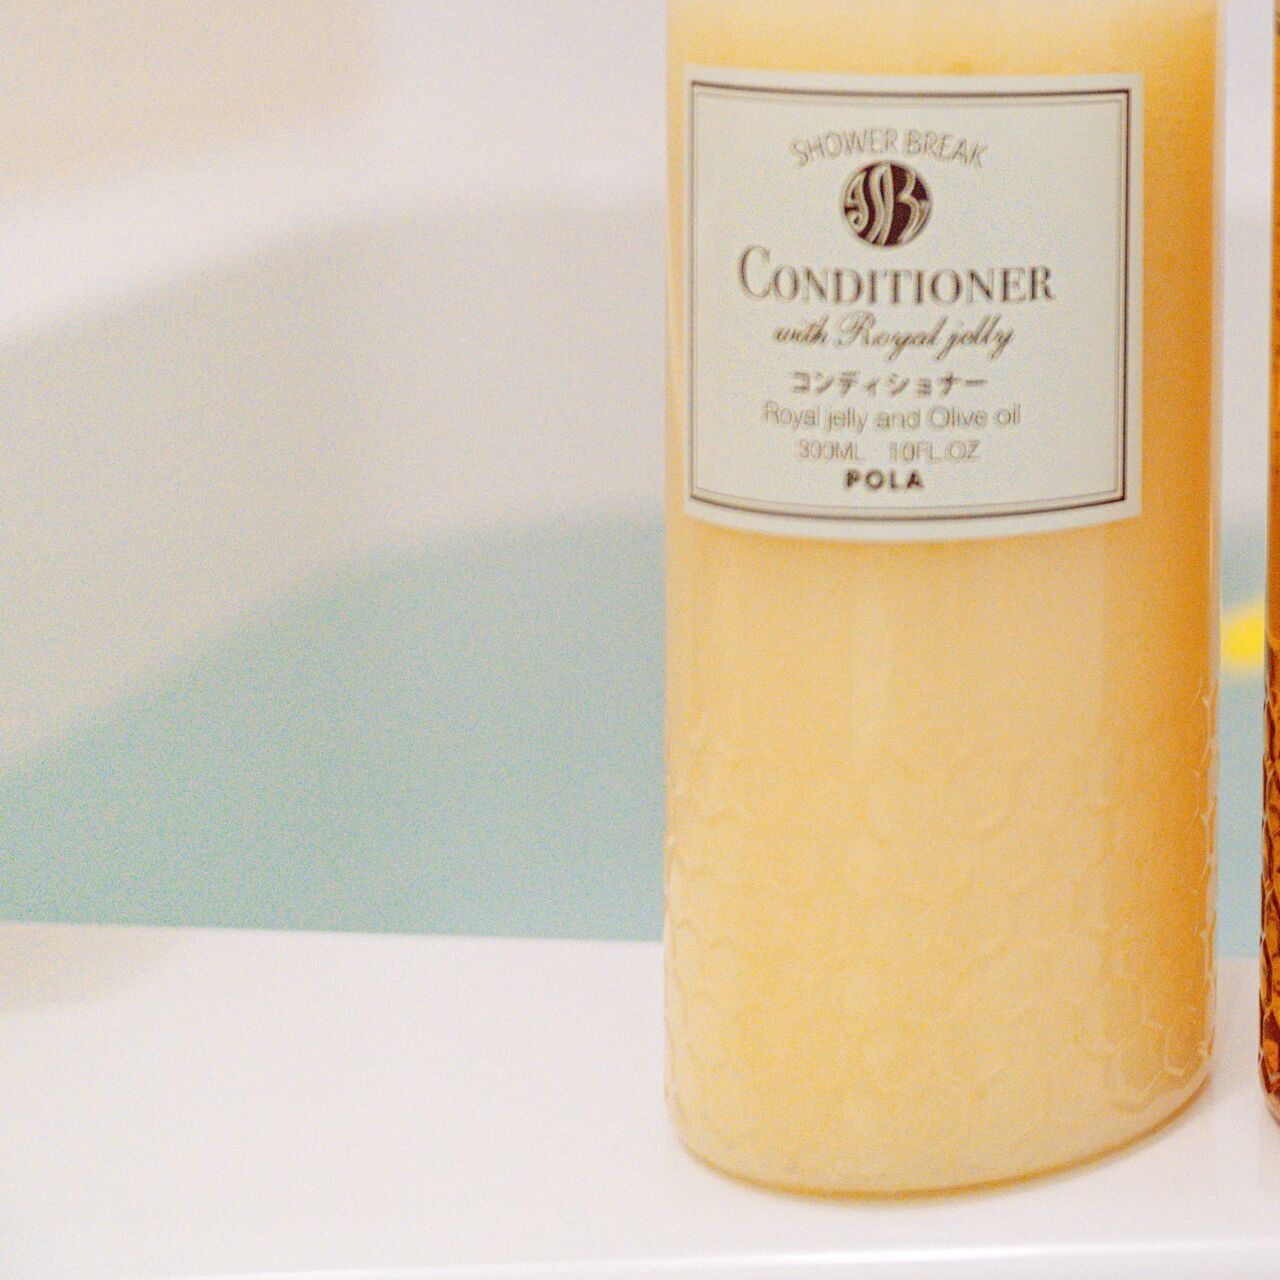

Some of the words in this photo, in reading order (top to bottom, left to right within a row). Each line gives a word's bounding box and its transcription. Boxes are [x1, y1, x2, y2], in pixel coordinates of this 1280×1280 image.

[791, 128, 898, 168] SHOWER
[906, 130, 990, 169] BREAK
[737, 244, 1056, 305] CONDITIONER
[772, 316, 830, 346] with
[833, 311, 948, 360] Royal
[937, 315, 1015, 361] jelly
[792, 370, 989, 398] コンディショナー
[762, 401, 821, 430] Royal
[825, 405, 868, 433] jelly
[875, 406, 922, 430] and
[929, 405, 987, 430] Olive
[997, 403, 1022, 427] oil
[798, 440, 865, 462] 300ML
[845, 468, 925, 491] POLA
